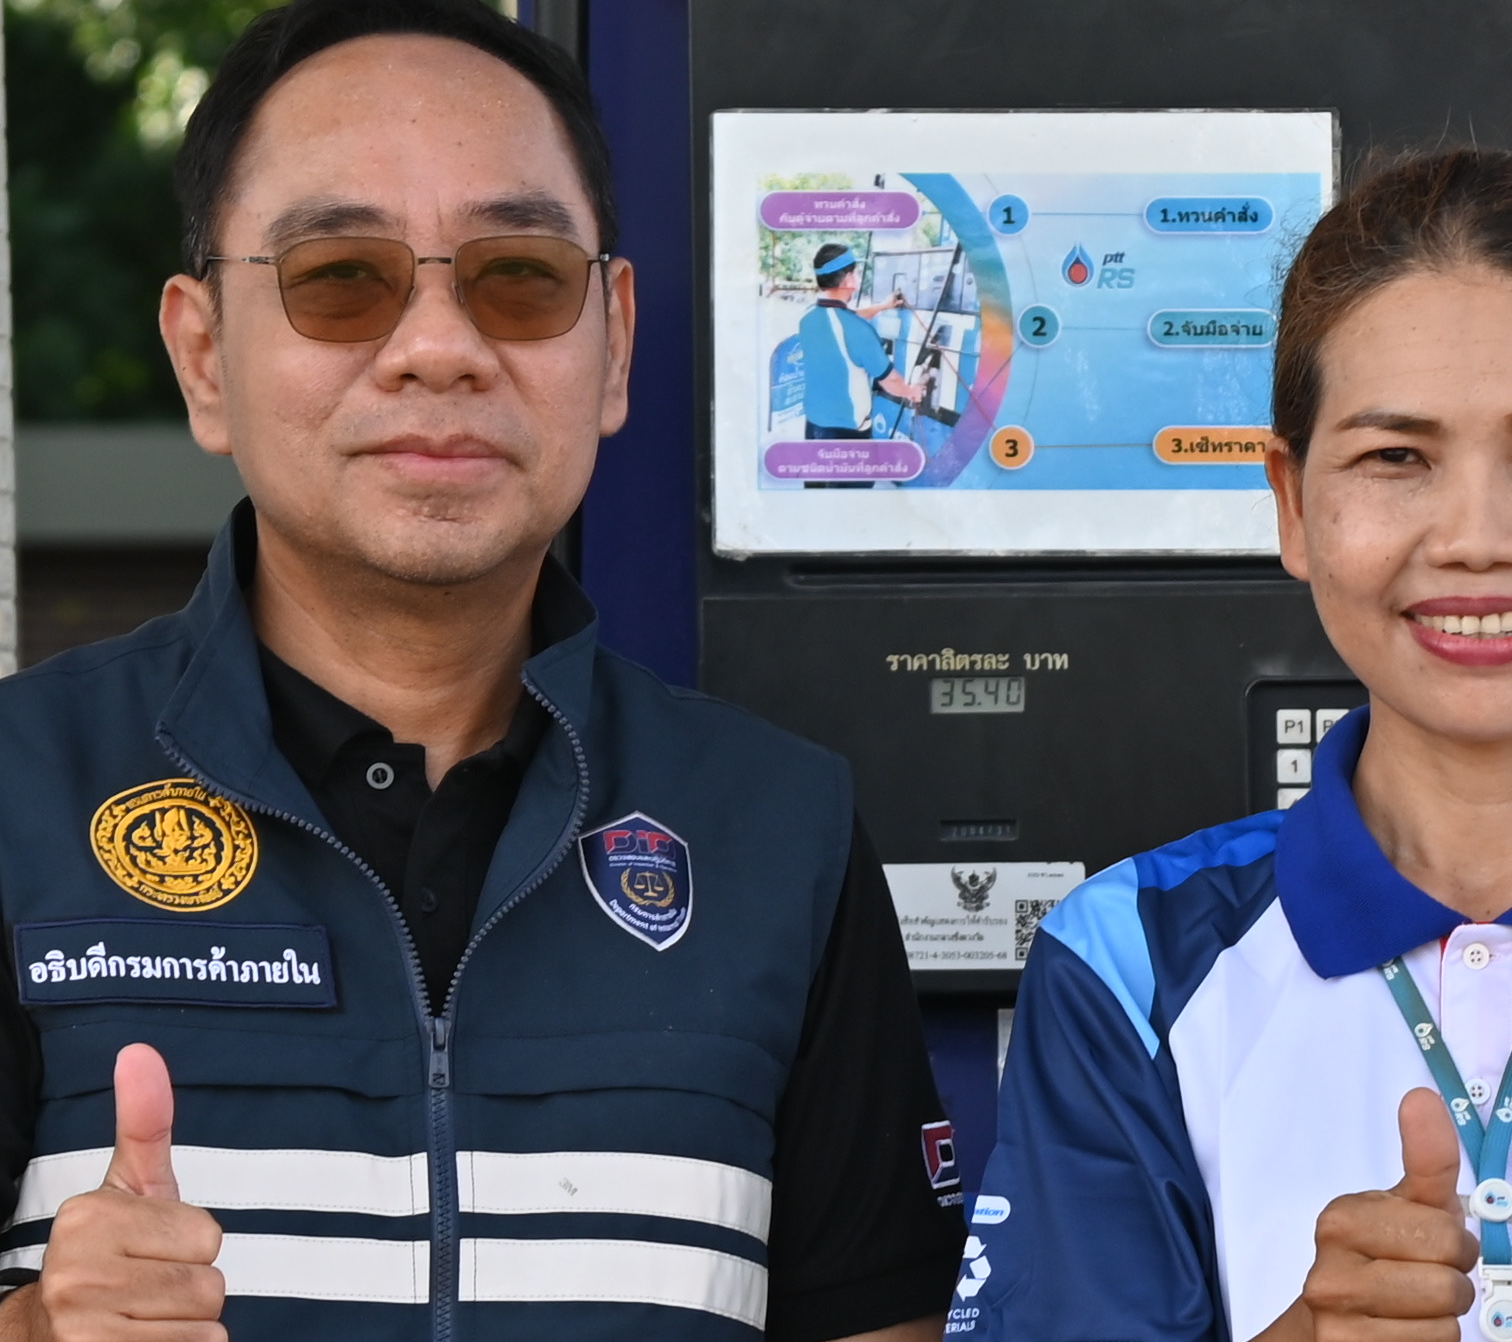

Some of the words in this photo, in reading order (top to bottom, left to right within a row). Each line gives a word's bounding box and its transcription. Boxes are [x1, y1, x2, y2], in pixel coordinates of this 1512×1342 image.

[1002, 207, 1015, 224] 1
[1159, 202, 1259, 224] 1.ทวนคำสั่ง
[1102, 251, 1125, 266] ptt
[1096, 267, 1135, 289] RS
[1031, 316, 1048, 337] 2
[1163, 321, 1263, 337] 2.จับมือจ่าย
[1004, 438, 1019, 458] 3
[886, 646, 1010, 672] ราคาลิตรละ
[1023, 649, 1069, 671] บาท
[940, 677, 1022, 708] 35.40
[1284, 720, 1305, 734] P1
[1290, 760, 1298, 773] 1
[608, 898, 649, 931] Department
[28, 941, 321, 987] อธิบดีกรมการค้าภายใน
